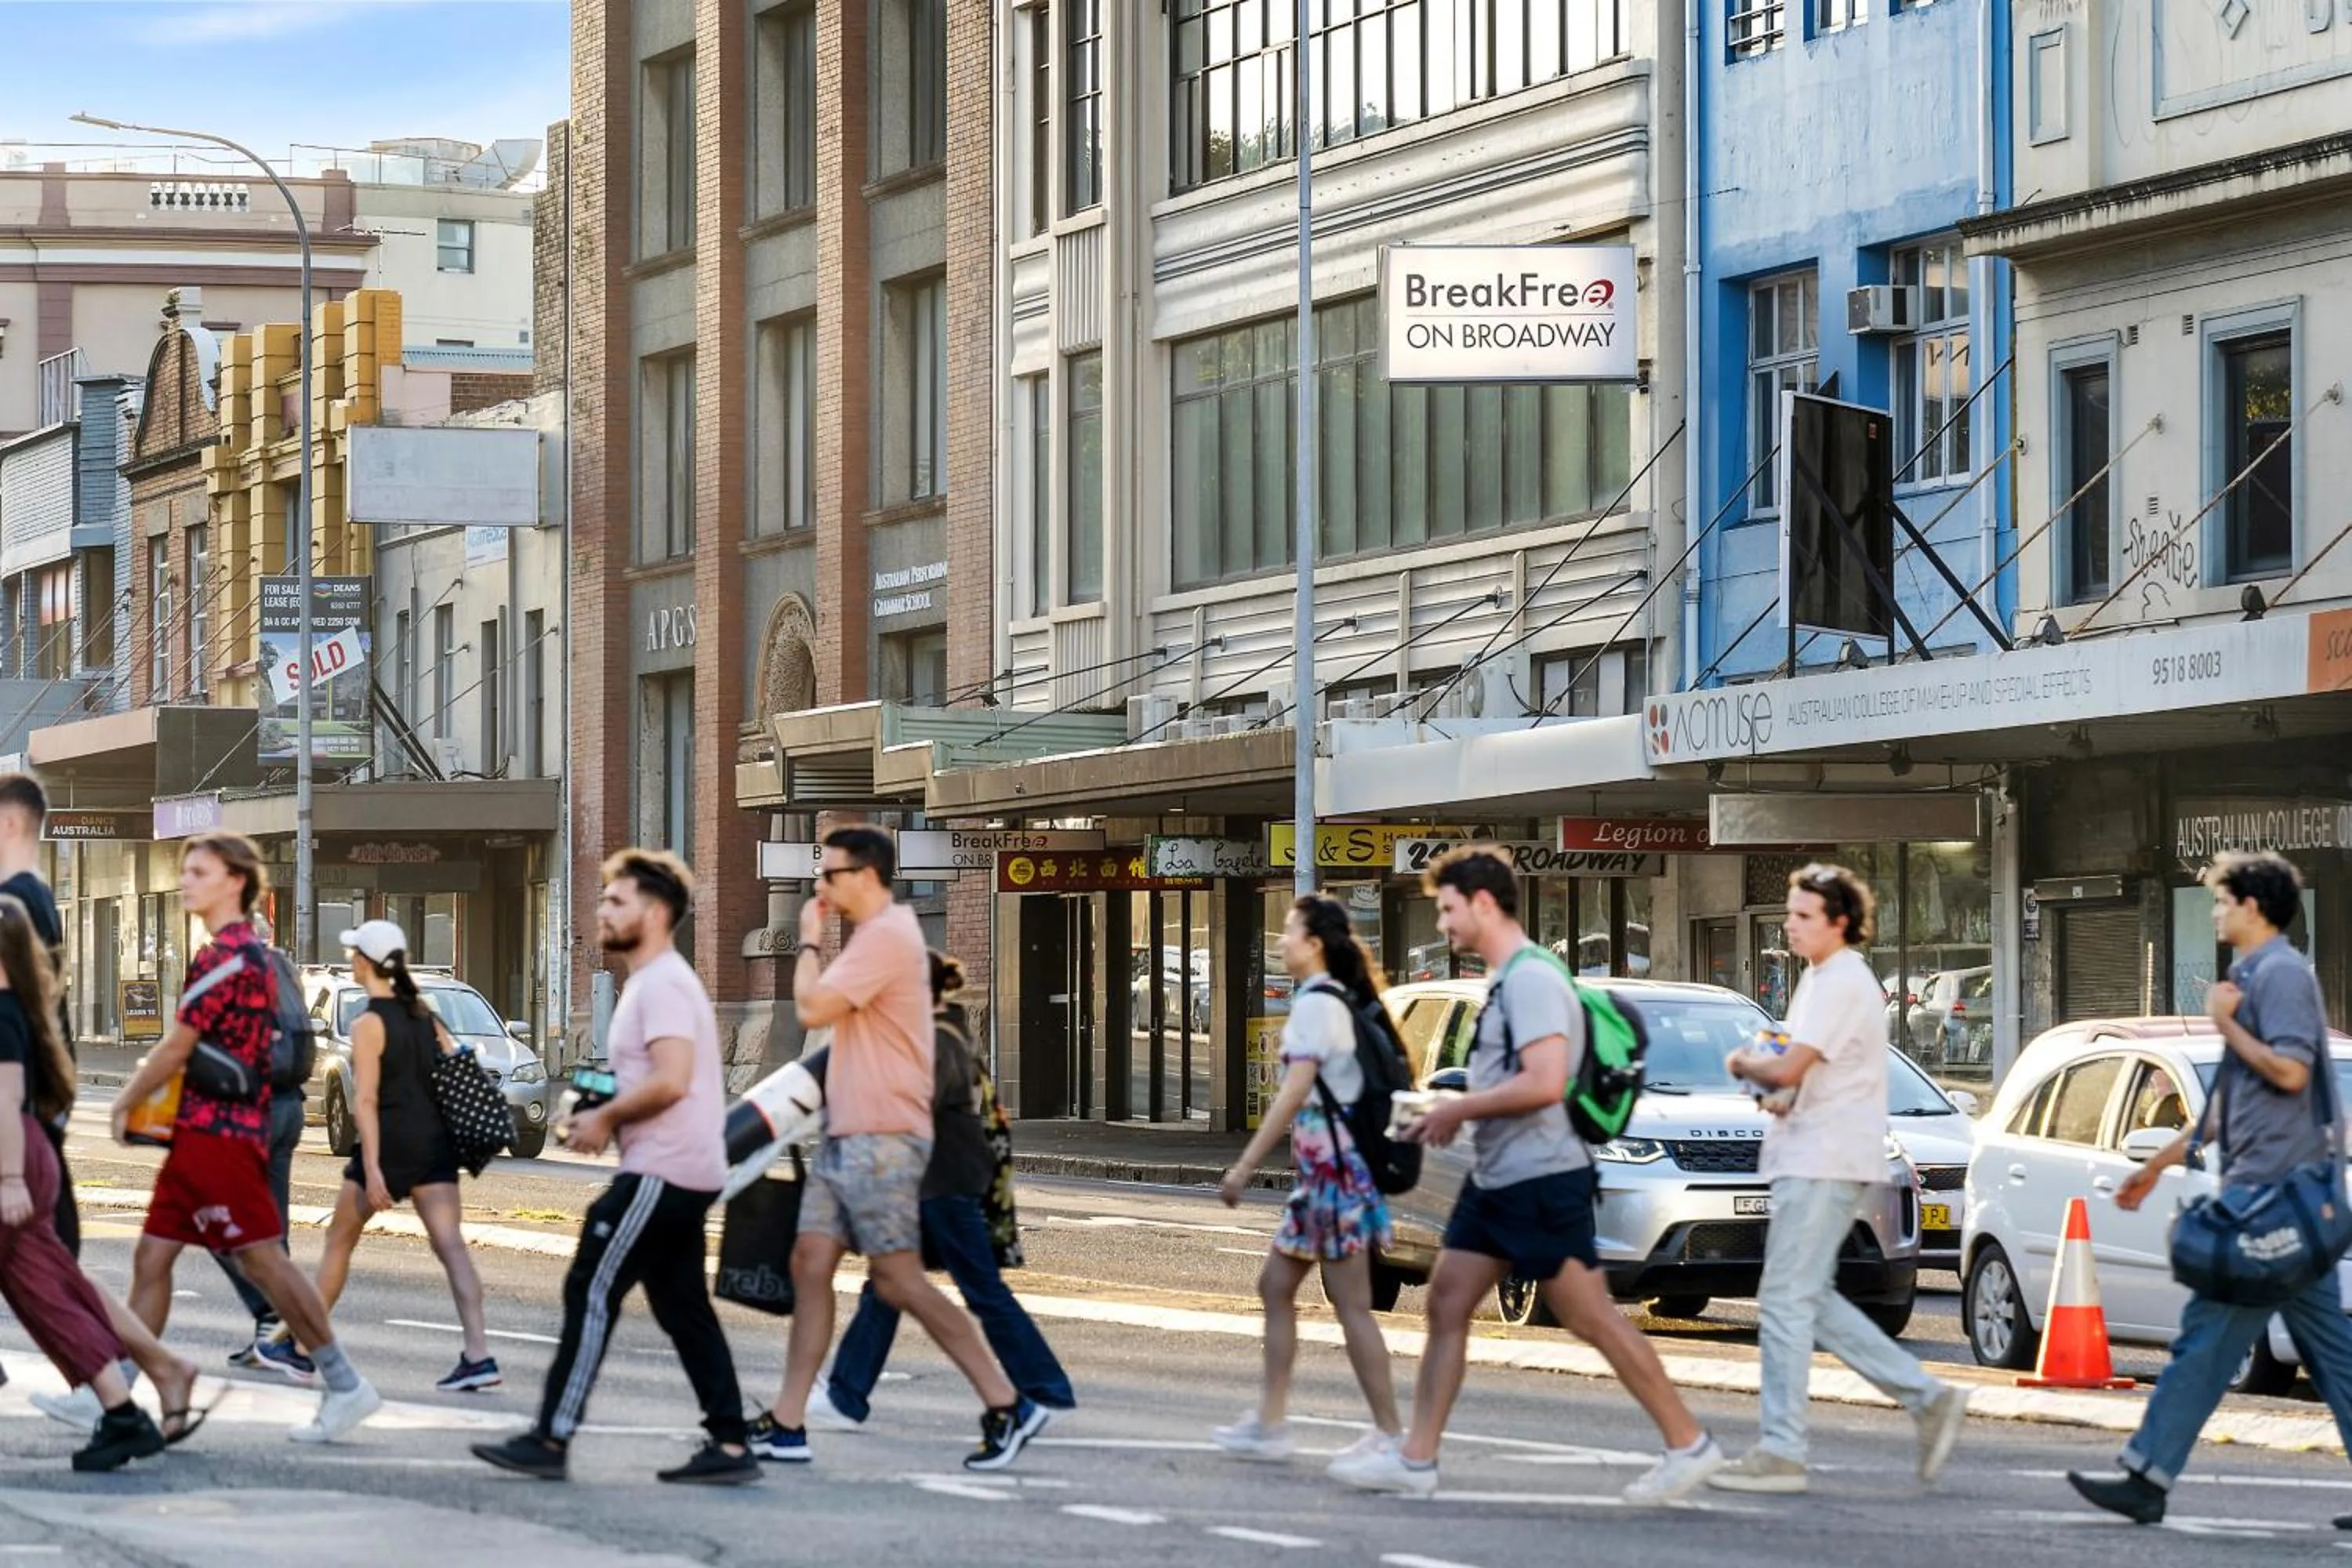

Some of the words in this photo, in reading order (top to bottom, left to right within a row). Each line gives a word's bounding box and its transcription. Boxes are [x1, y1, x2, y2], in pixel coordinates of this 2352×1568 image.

[1406, 273, 1614, 308] BreakFree
[1406, 323, 1453, 348] ON
[1463, 322, 1616, 348] BROADWAY
[264, 584, 280, 595] FOR
[281, 584, 301, 595] SALE
[264, 597, 289, 608] LEASE
[906, 591, 931, 612] SCHOOL
[646, 604, 696, 652] APGS
[2153, 655, 2186, 685] 9518
[2188, 651, 2222, 681] 8003
[1787, 695, 1852, 727] AUSTRALIAN
[1853, 689, 1900, 720] COLLEGE
[1902, 688, 1915, 713] OF
[1968, 679, 1992, 705] AND
[1994, 675, 2040, 703] SPECIAL
[2042, 669, 2092, 699] EFFECTS
[52, 826, 116, 837] AUSTRALIA
[951, 832, 1048, 849] BreakFree
[1318, 836, 1339, 862] &
[1346, 829, 1375, 862] S
[1594, 822, 1686, 850] Legion
[2176, 813, 2261, 858] AUSTRALIAN
[2265, 807, 2332, 851] COLLEGE
[953, 853, 975, 866] ON
[719, 1264, 788, 1301] reb
